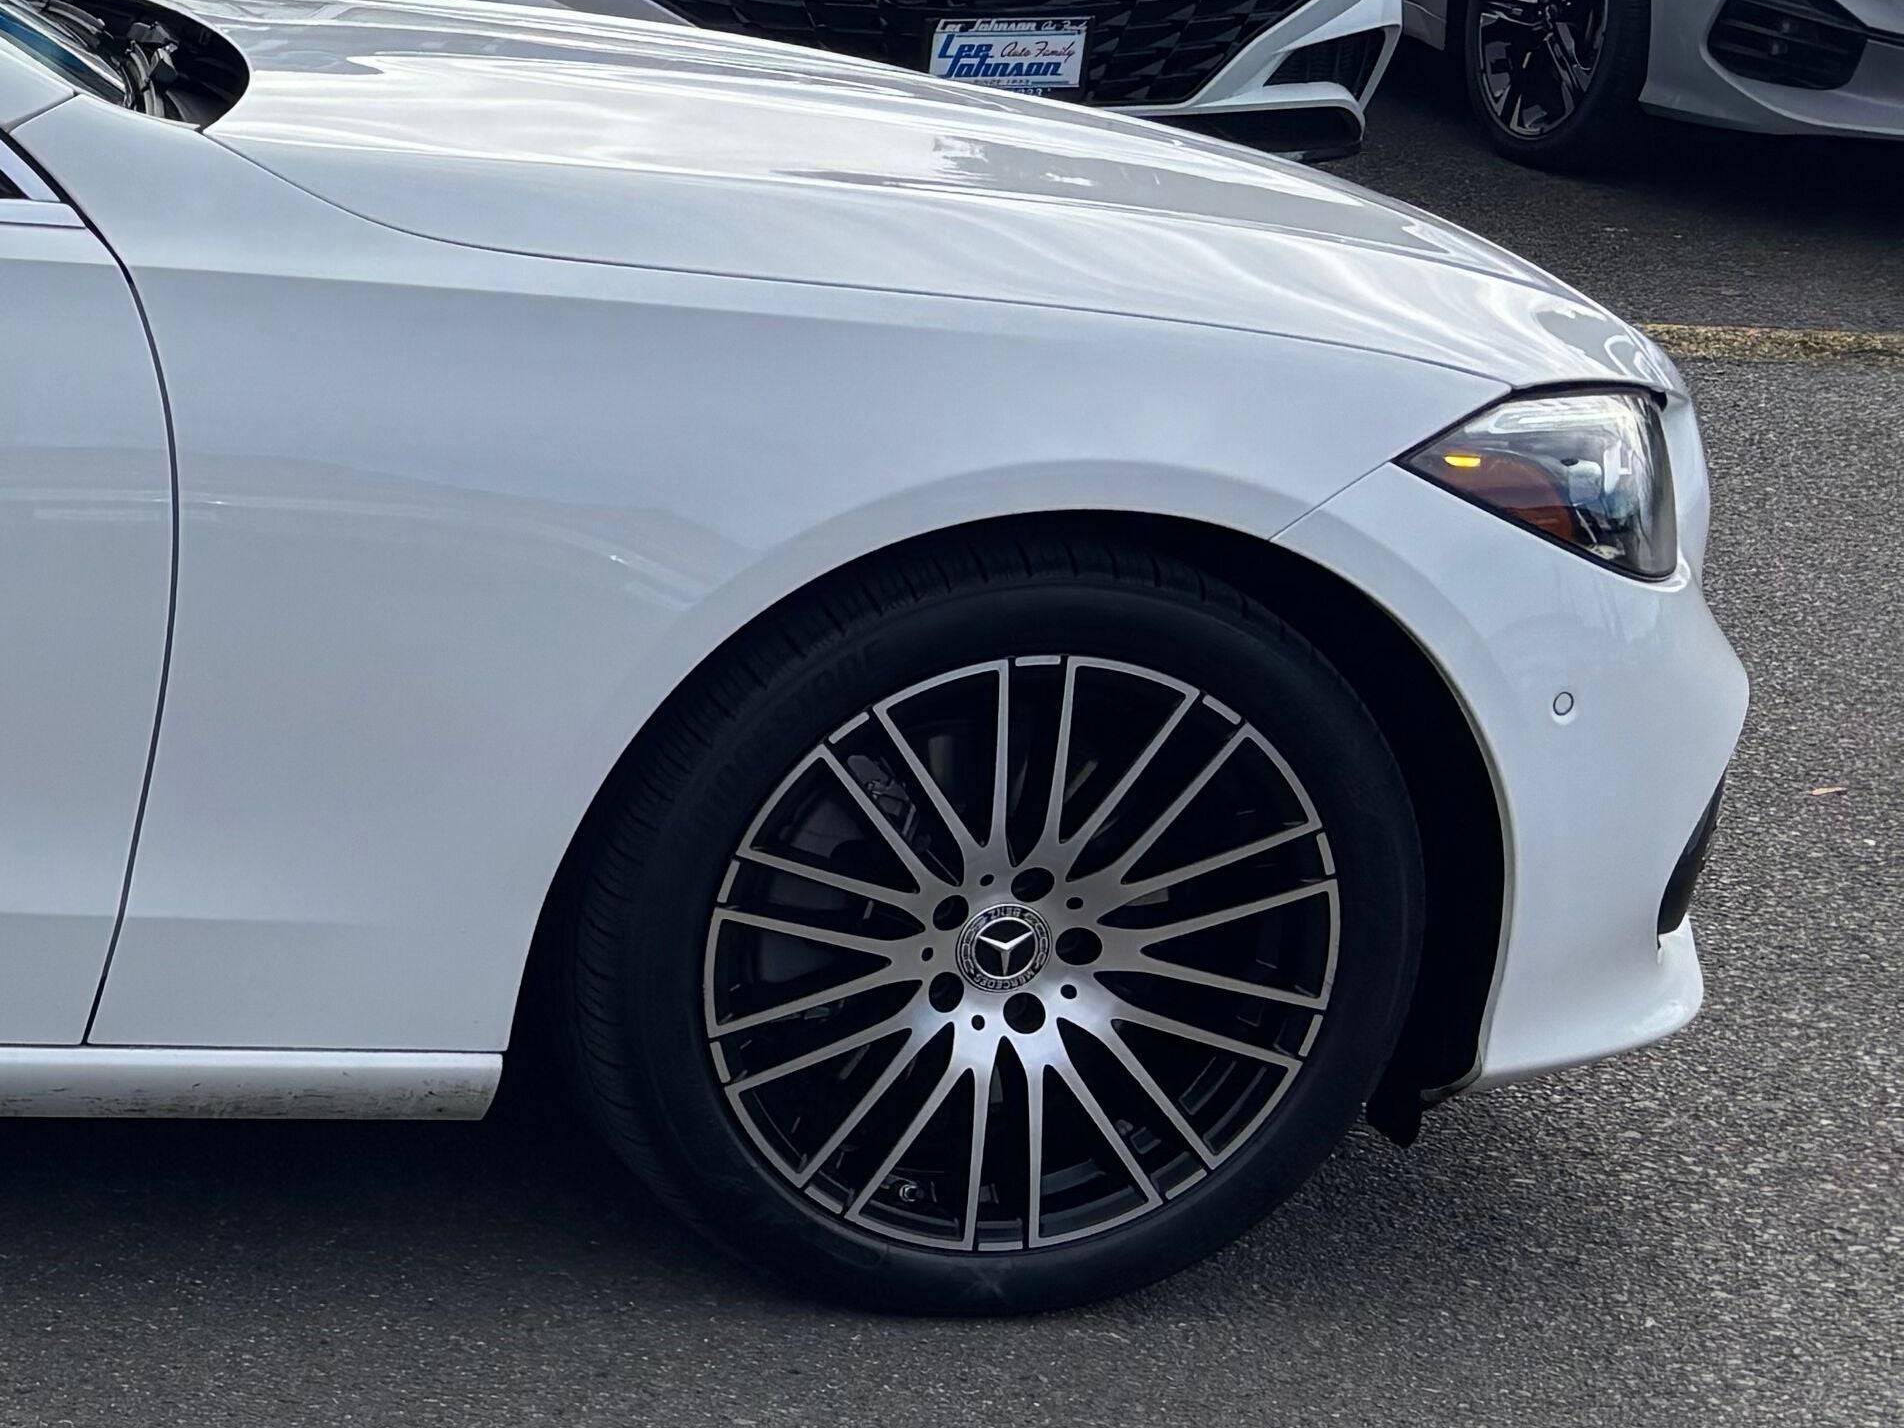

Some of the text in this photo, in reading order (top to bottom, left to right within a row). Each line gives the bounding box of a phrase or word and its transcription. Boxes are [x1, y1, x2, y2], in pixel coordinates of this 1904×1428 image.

[968, 18, 1037, 32] Johnson
[938, 33, 1076, 64] Lee Auto Family
[937, 55, 1063, 78] Johnson
[973, 969, 1035, 989] MERCEDES
